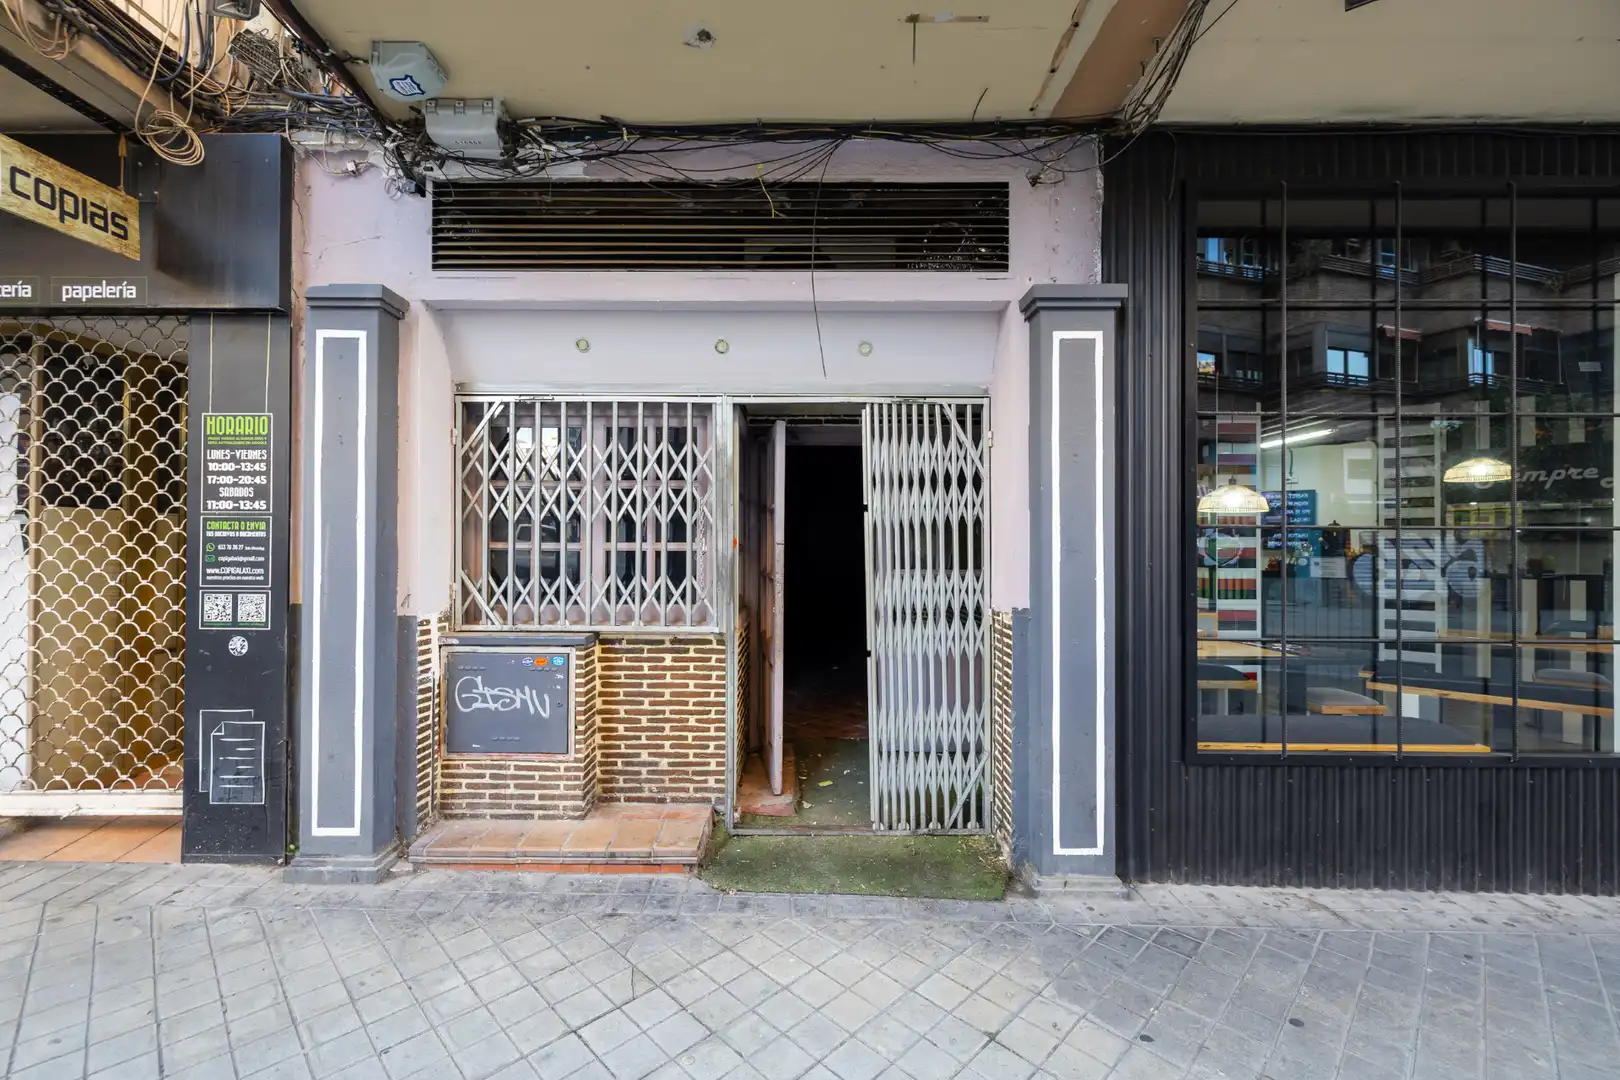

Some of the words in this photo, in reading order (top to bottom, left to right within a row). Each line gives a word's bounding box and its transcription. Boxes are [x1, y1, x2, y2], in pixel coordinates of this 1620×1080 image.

[9, 165, 129, 241] copias
[0, 280, 32, 297] ería
[62, 280, 137, 302] papelería
[206, 416, 268, 435] HORARIO
[207, 449, 268, 460] LUNES-VIERNES
[208, 462, 267, 471] 10:00-13:45
[206, 475, 268, 485] 17:00-20:45
[219, 487, 255, 498] SABADOS
[206, 500, 268, 510] 11:00-13:45
[206, 521, 239, 531] CONTACTA
[240, 521, 246, 531] O
